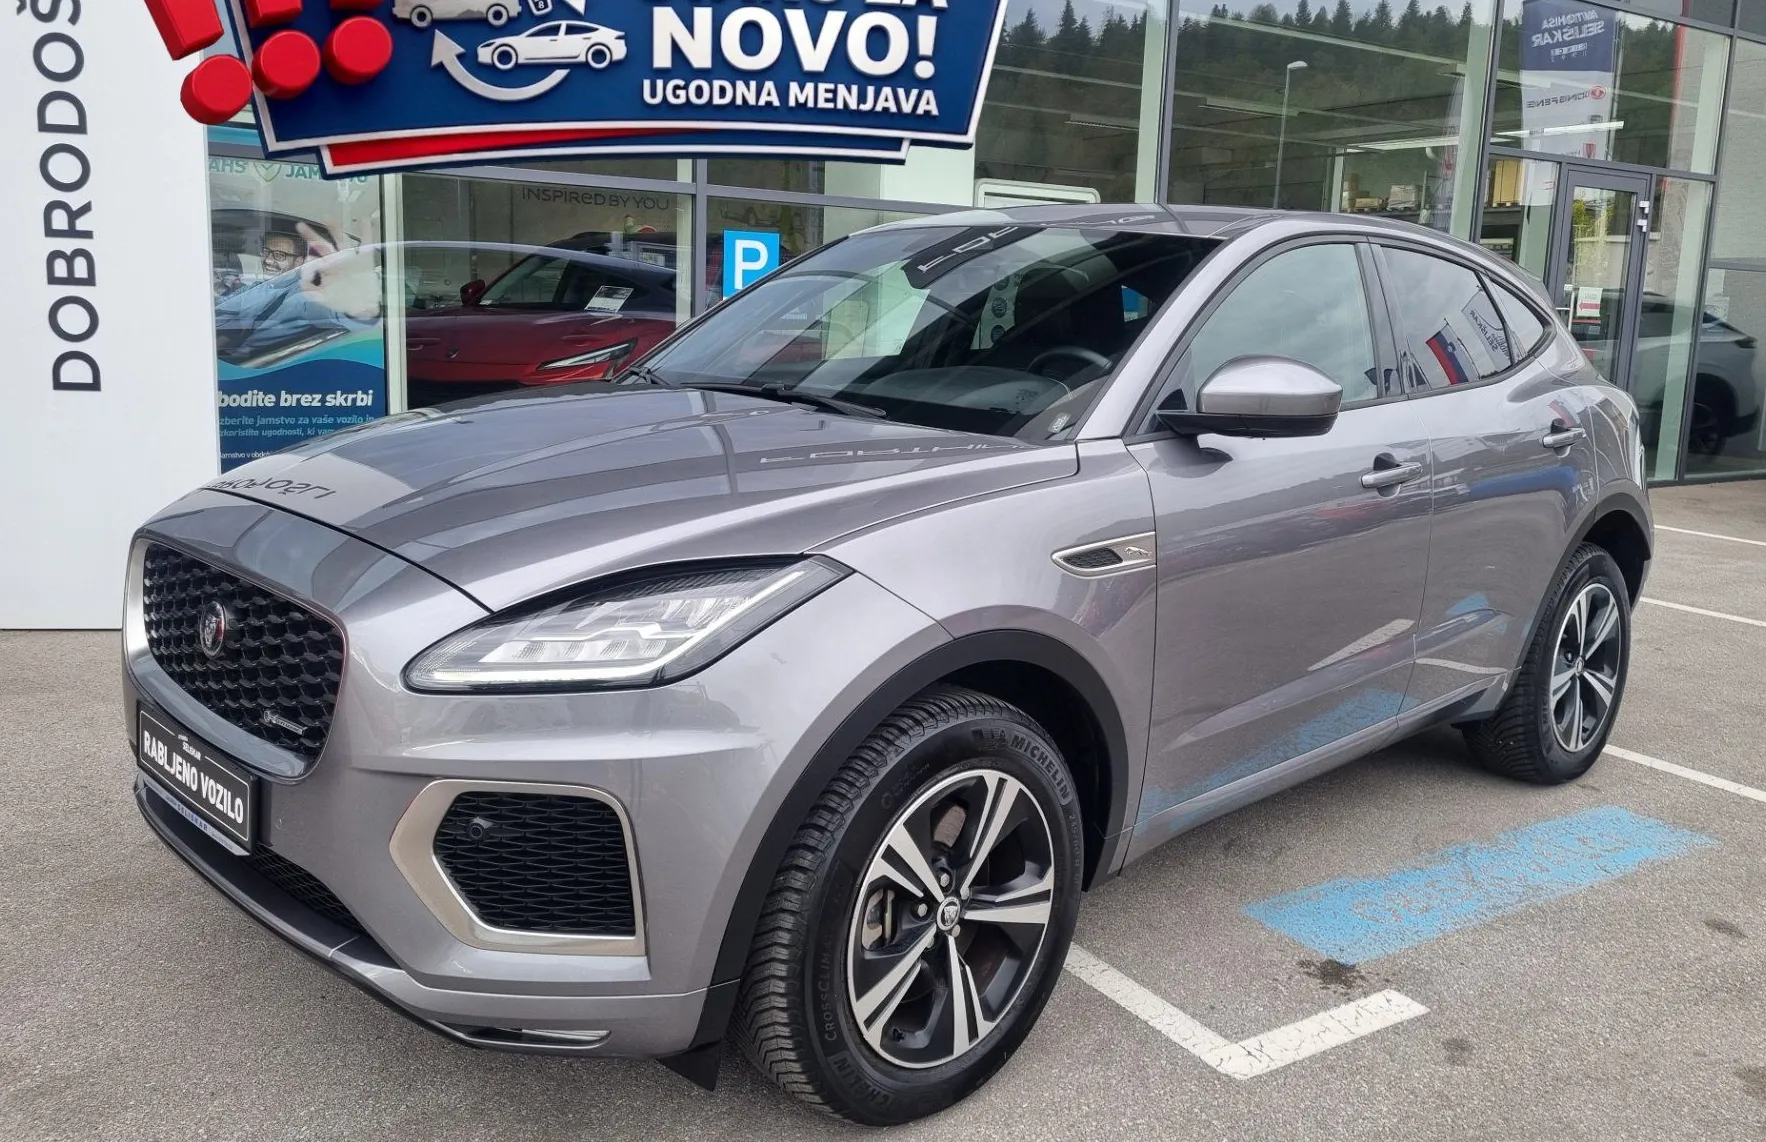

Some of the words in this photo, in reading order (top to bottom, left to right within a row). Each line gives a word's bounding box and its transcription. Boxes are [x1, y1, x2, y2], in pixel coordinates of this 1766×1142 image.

[609, 195, 631, 208] BY
[634, 196, 669, 211] YOU
[735, 239, 768, 290] P
[219, 389, 275, 408] bodite
[279, 390, 322, 408] brez
[325, 389, 374, 407] skrbi
[220, 415, 255, 426] zberite
[256, 415, 296, 426] jamstvo
[312, 414, 334, 425] vaše
[336, 415, 364, 424] vozilo
[144, 730, 198, 792] RABLJENO
[200, 772, 244, 824] VOZILO
[1012, 735, 1070, 800] MICHELIN
